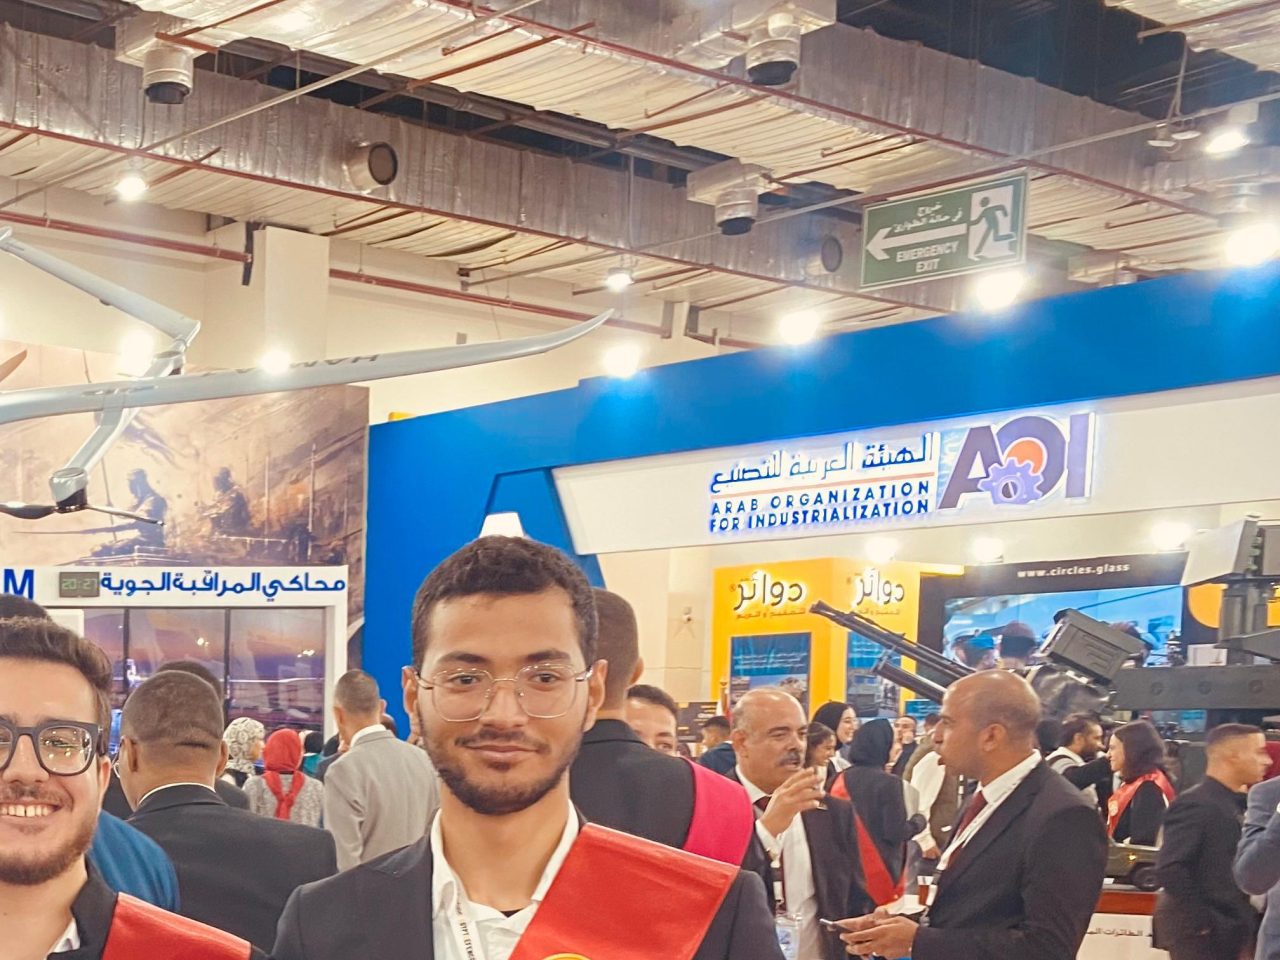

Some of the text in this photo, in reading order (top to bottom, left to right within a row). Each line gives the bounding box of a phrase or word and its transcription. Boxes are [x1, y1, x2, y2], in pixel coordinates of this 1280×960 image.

[896, 241, 960, 263] EMERGENCY
[915, 258, 941, 273] EXIT
[710, 431, 941, 494] الهيئة العربية للتصنيع
[937, 412, 1096, 510] AOI
[711, 480, 930, 516] ARAB ORGANIZATION
[710, 499, 929, 533] FOR INDUSTRIALIZATION
[100, 570, 346, 602] محاكي المراقبة الجوية
[856, 568, 905, 606] دوائر
[1017, 562, 1131, 578] www.circles.glass
[733, 571, 803, 611] دوائر
